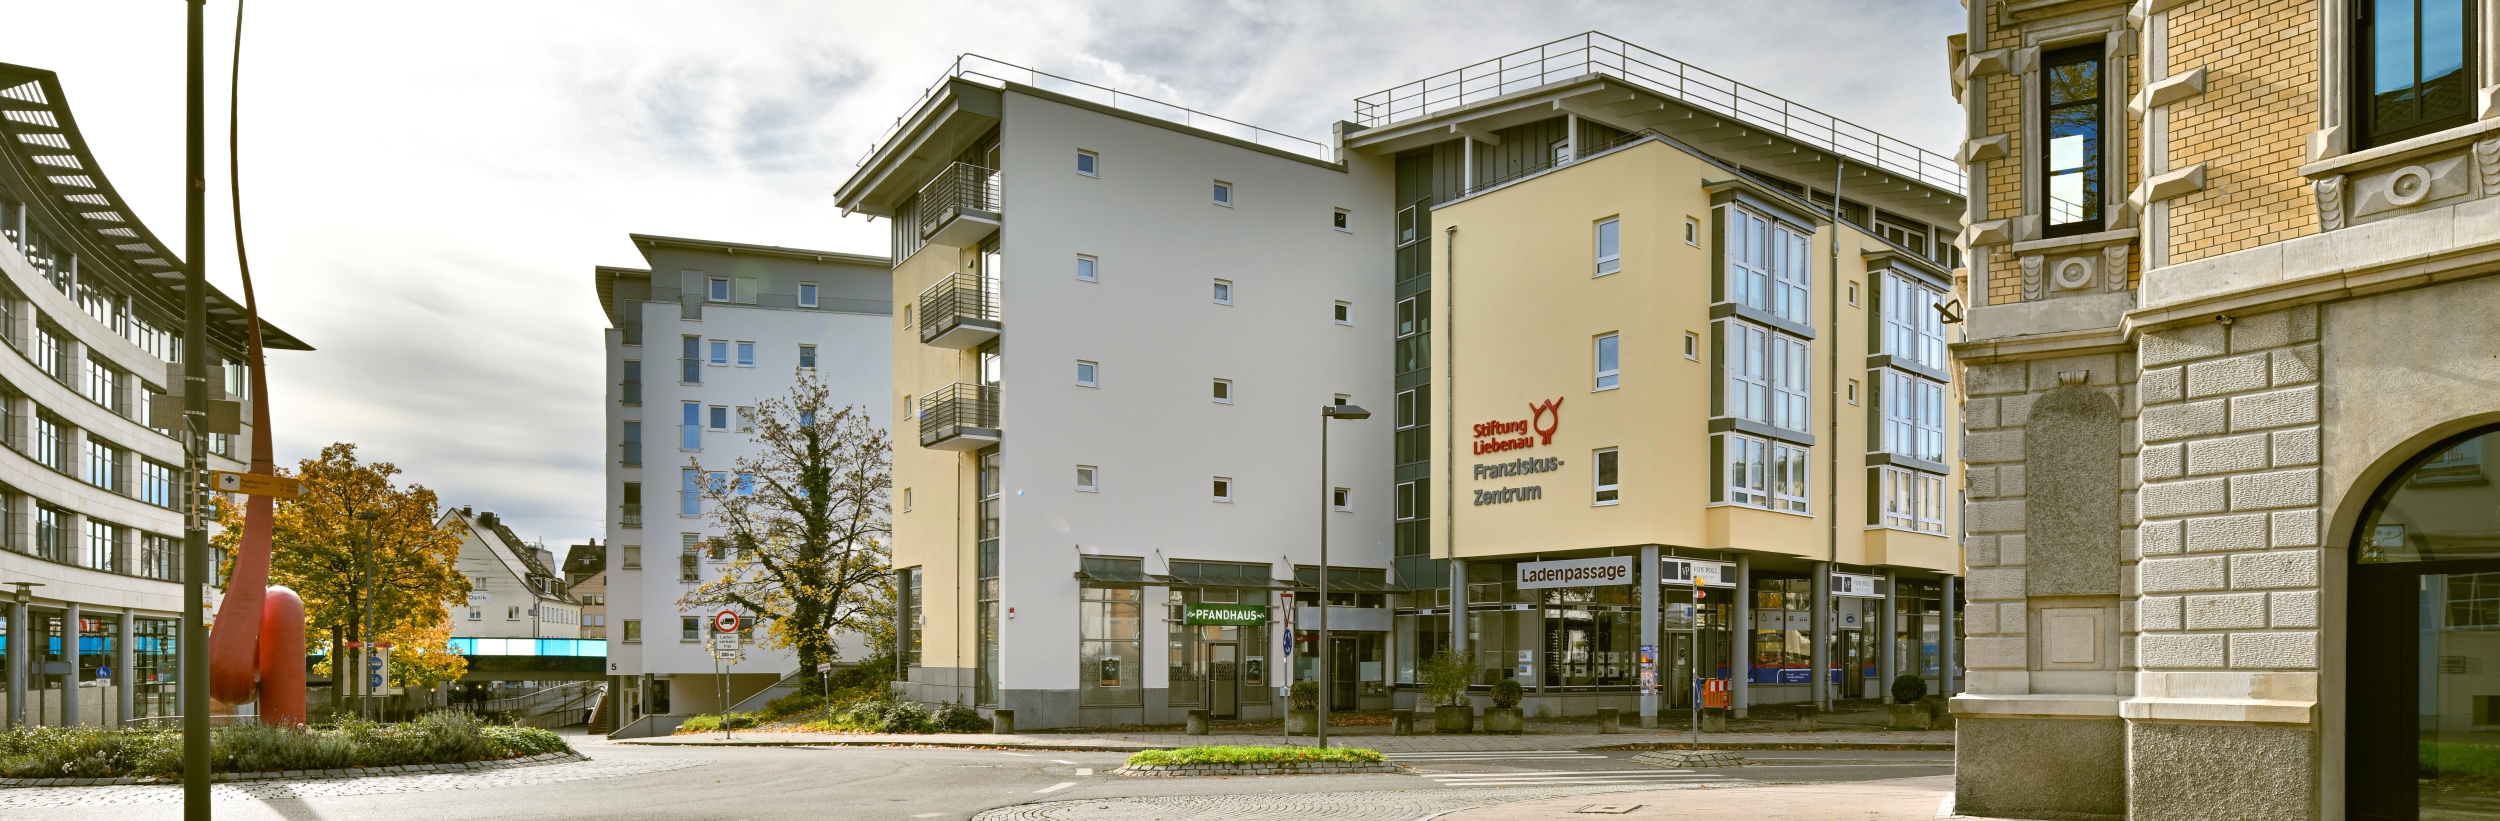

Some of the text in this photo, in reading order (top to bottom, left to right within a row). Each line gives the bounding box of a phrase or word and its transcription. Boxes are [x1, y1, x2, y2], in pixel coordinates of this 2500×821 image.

[1473, 420, 1528, 438] Stiftung
[1473, 436, 1534, 455] Liebenau
[1474, 456, 1565, 480] Franziskus-
[1473, 485, 1542, 506] Zentrum
[1521, 564, 1627, 583] Ladenpassage
[1196, 609, 1257, 620] PFANDHAUS
[611, 663, 617, 671] 5
